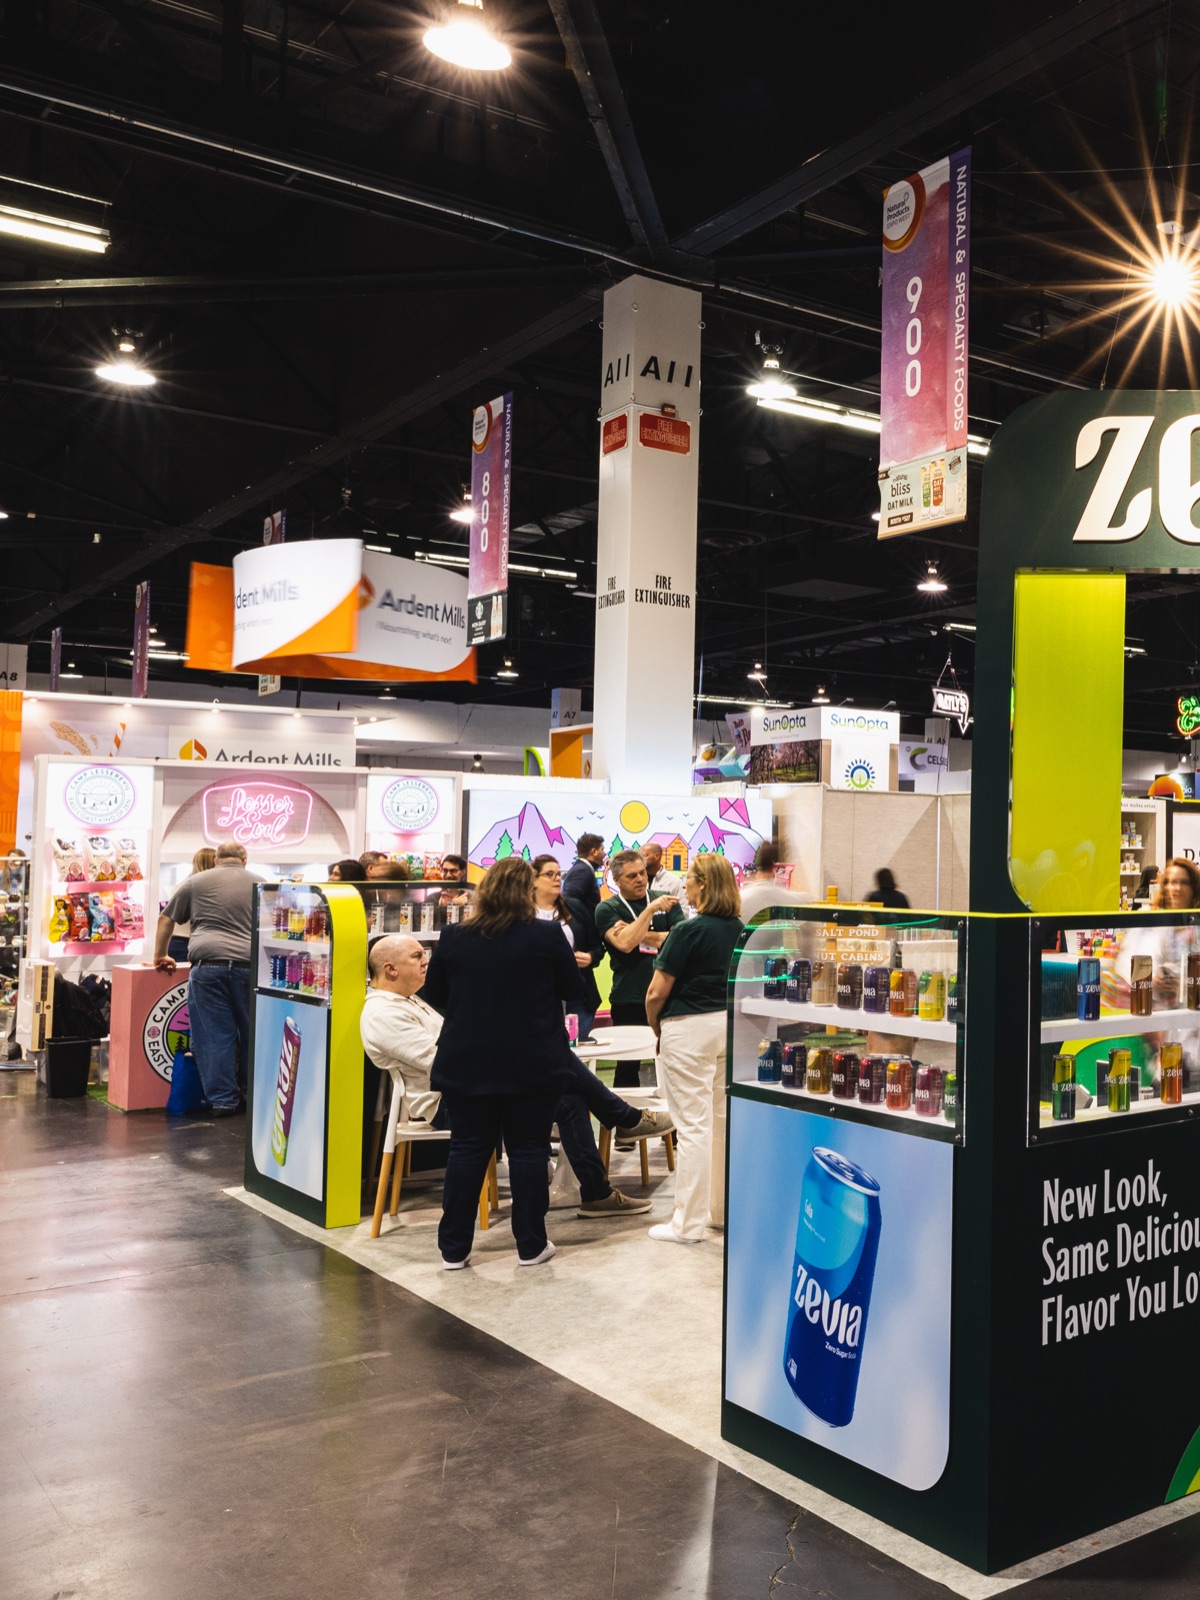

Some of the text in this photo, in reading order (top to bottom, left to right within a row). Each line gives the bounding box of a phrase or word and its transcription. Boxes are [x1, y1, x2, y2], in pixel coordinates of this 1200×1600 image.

[956, 165, 967, 246] NATURAL
[954, 272, 966, 364] SPECIALTY
[906, 276, 923, 397] 900
[953, 369, 965, 432] FOODS
[890, 483, 911, 498] bliss
[480, 471, 490, 553] 800
[888, 497, 913, 511] OAT MILK
[655, 575, 671, 590] FIRE
[234, 587, 259, 609] dent
[377, 588, 465, 629] Ardent Mills
[635, 588, 690, 608] EXTINGUISHER
[0, 671, 18, 682] A8
[564, 711, 576, 719] A7
[763, 715, 806, 733] SunOpta
[830, 713, 889, 732] SunOpta
[215, 747, 341, 767] Ardent Mills
[217, 788, 294, 827] Lesser
[816, 928, 879, 937] SALT POND
[841, 952, 884, 961] CABINS
[152, 988, 186, 1023] CAMP
[148, 1040, 168, 1067] EAST
[1043, 1159, 1168, 1226] New Look,
[1042, 1237, 1109, 1286] Same
[1042, 1292, 1120, 1346] Flavor
[1126, 1275, 1166, 1322] You
[825, 1341, 837, 1354] Zero
[836, 1347, 849, 1359] Sugar
